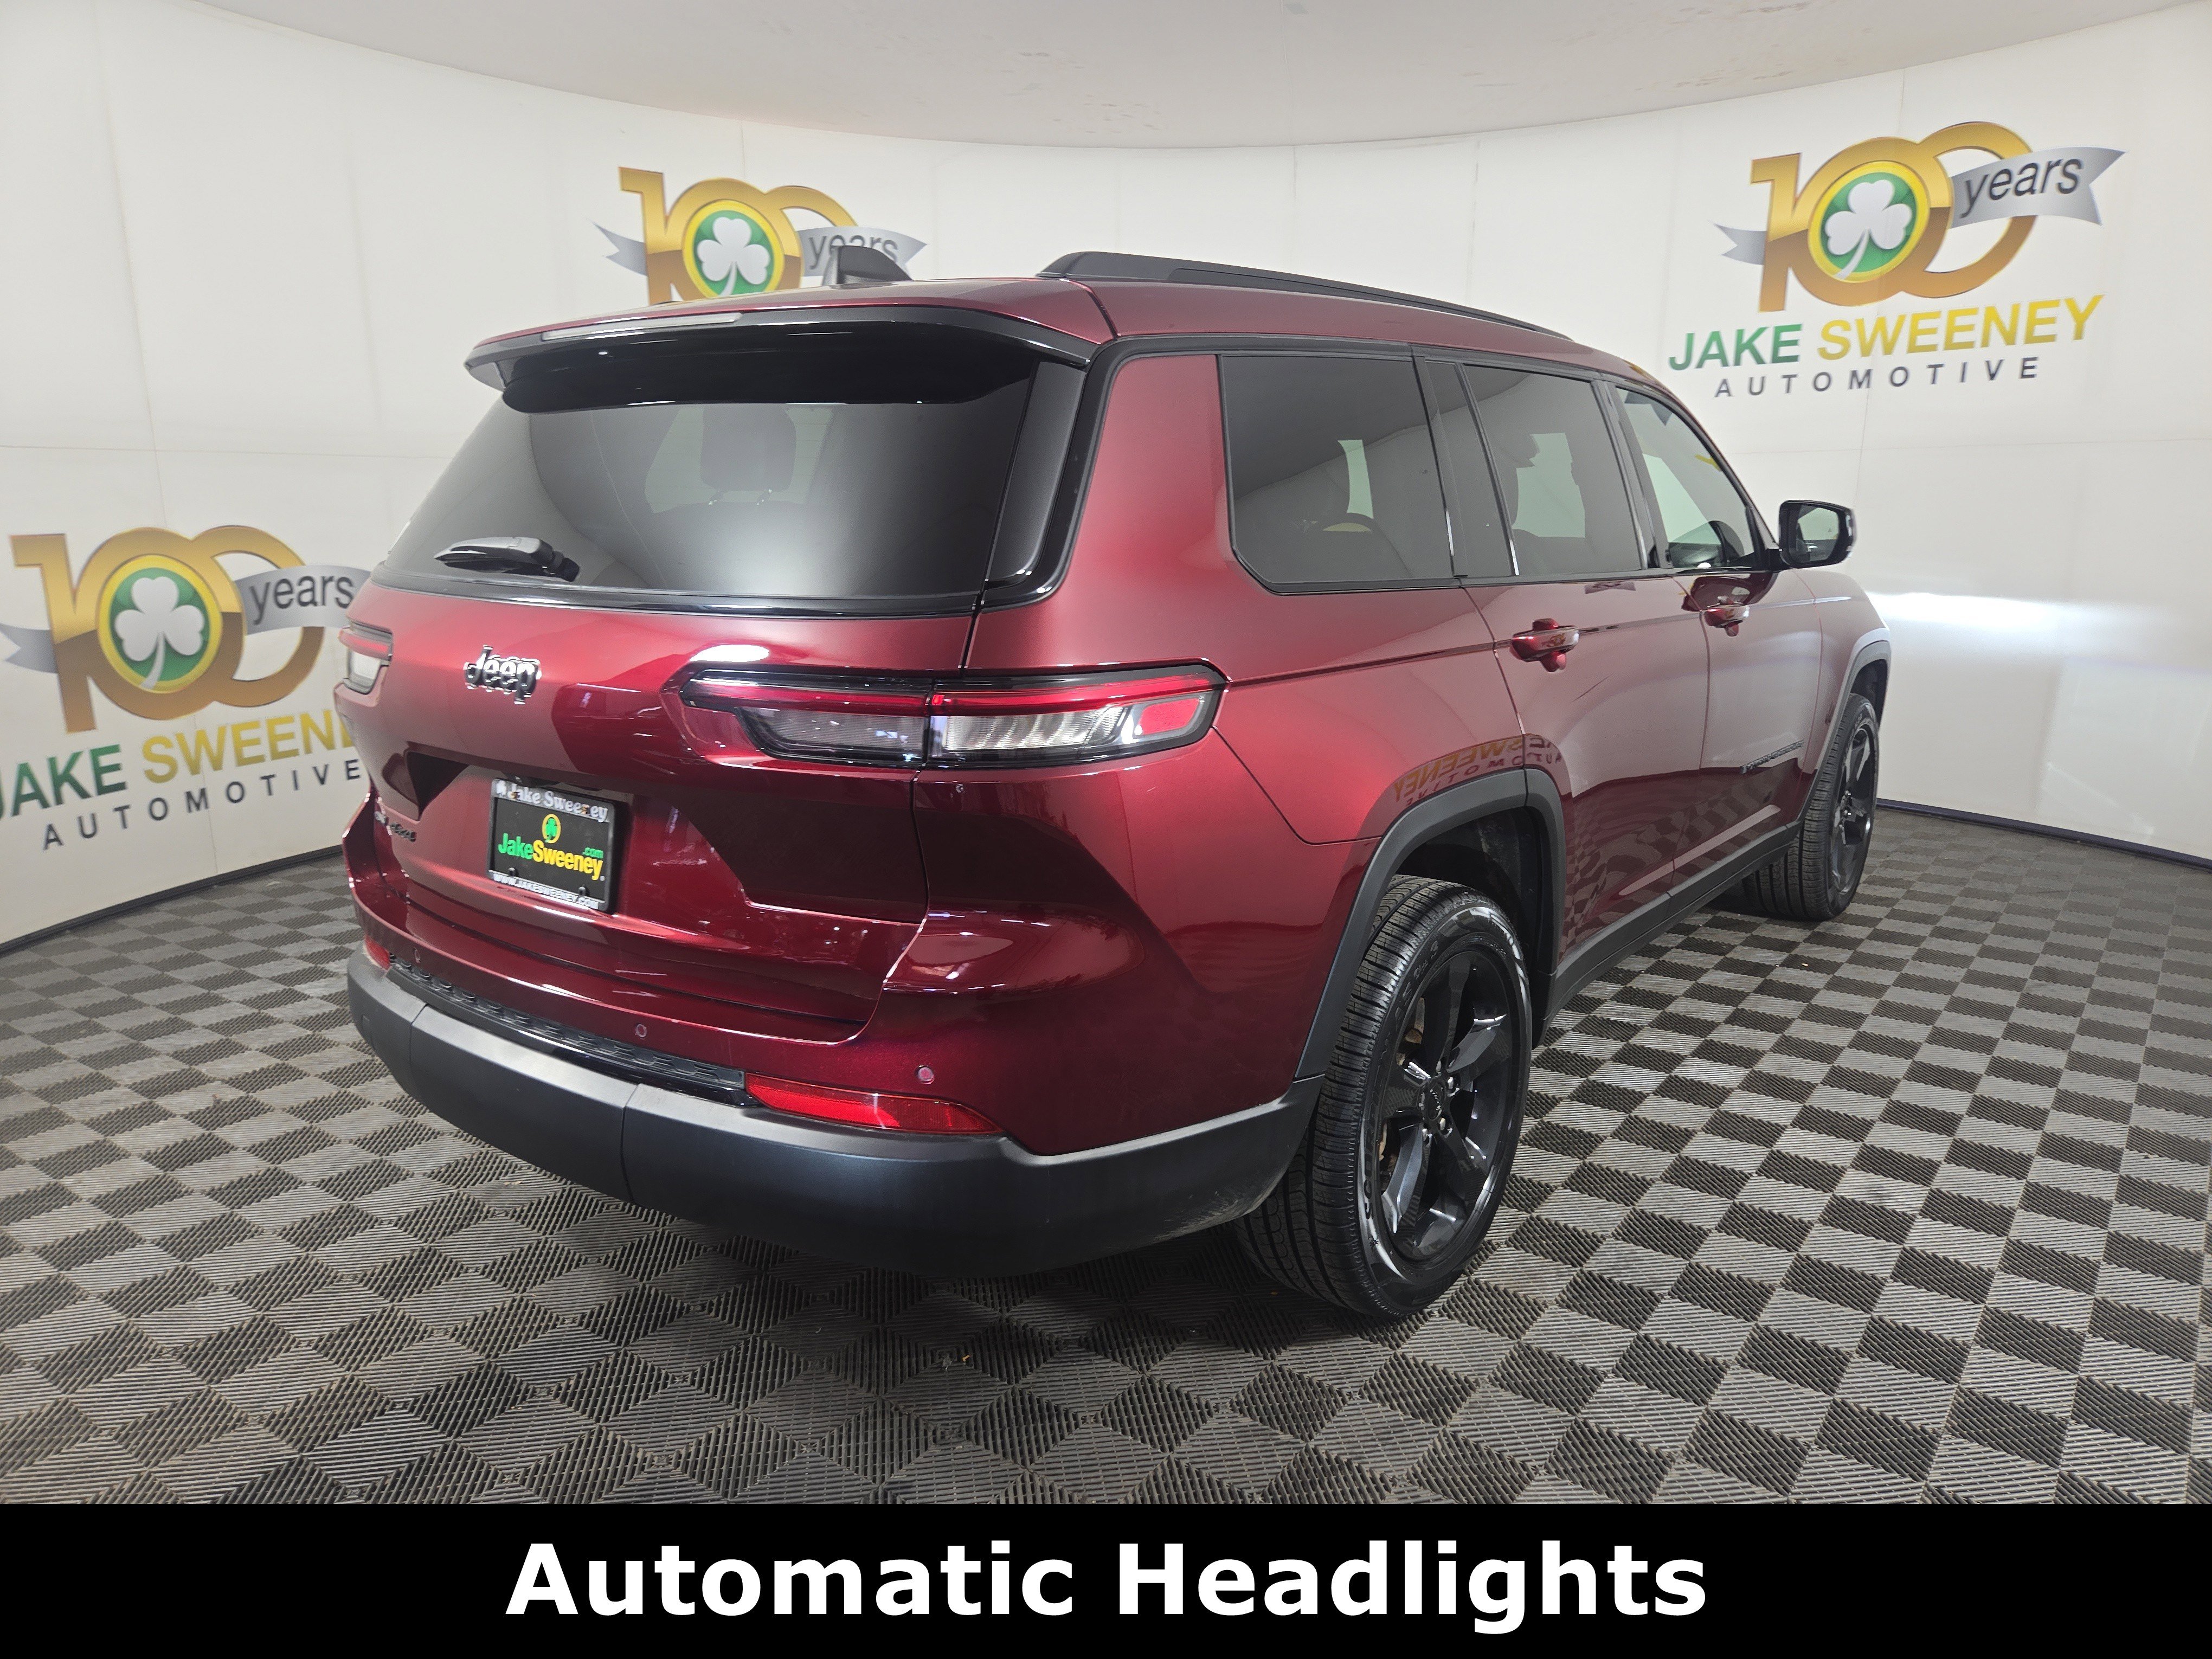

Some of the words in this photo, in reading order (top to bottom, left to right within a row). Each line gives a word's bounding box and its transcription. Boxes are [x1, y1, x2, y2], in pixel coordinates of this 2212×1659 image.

[1750, 121, 2038, 312] 100
[1960, 158, 2084, 218] years
[1668, 324, 1802, 371] JAKE
[1817, 294, 2104, 361] SWEENEY
[1714, 357, 2039, 398] AUTOMOTIVE
[8, 524, 325, 735] 100
[250, 574, 355, 625] years
[464, 645, 542, 704] Jeep
[0, 745, 127, 820] AKE
[43, 758, 361, 851] AUTOMOTIVE
